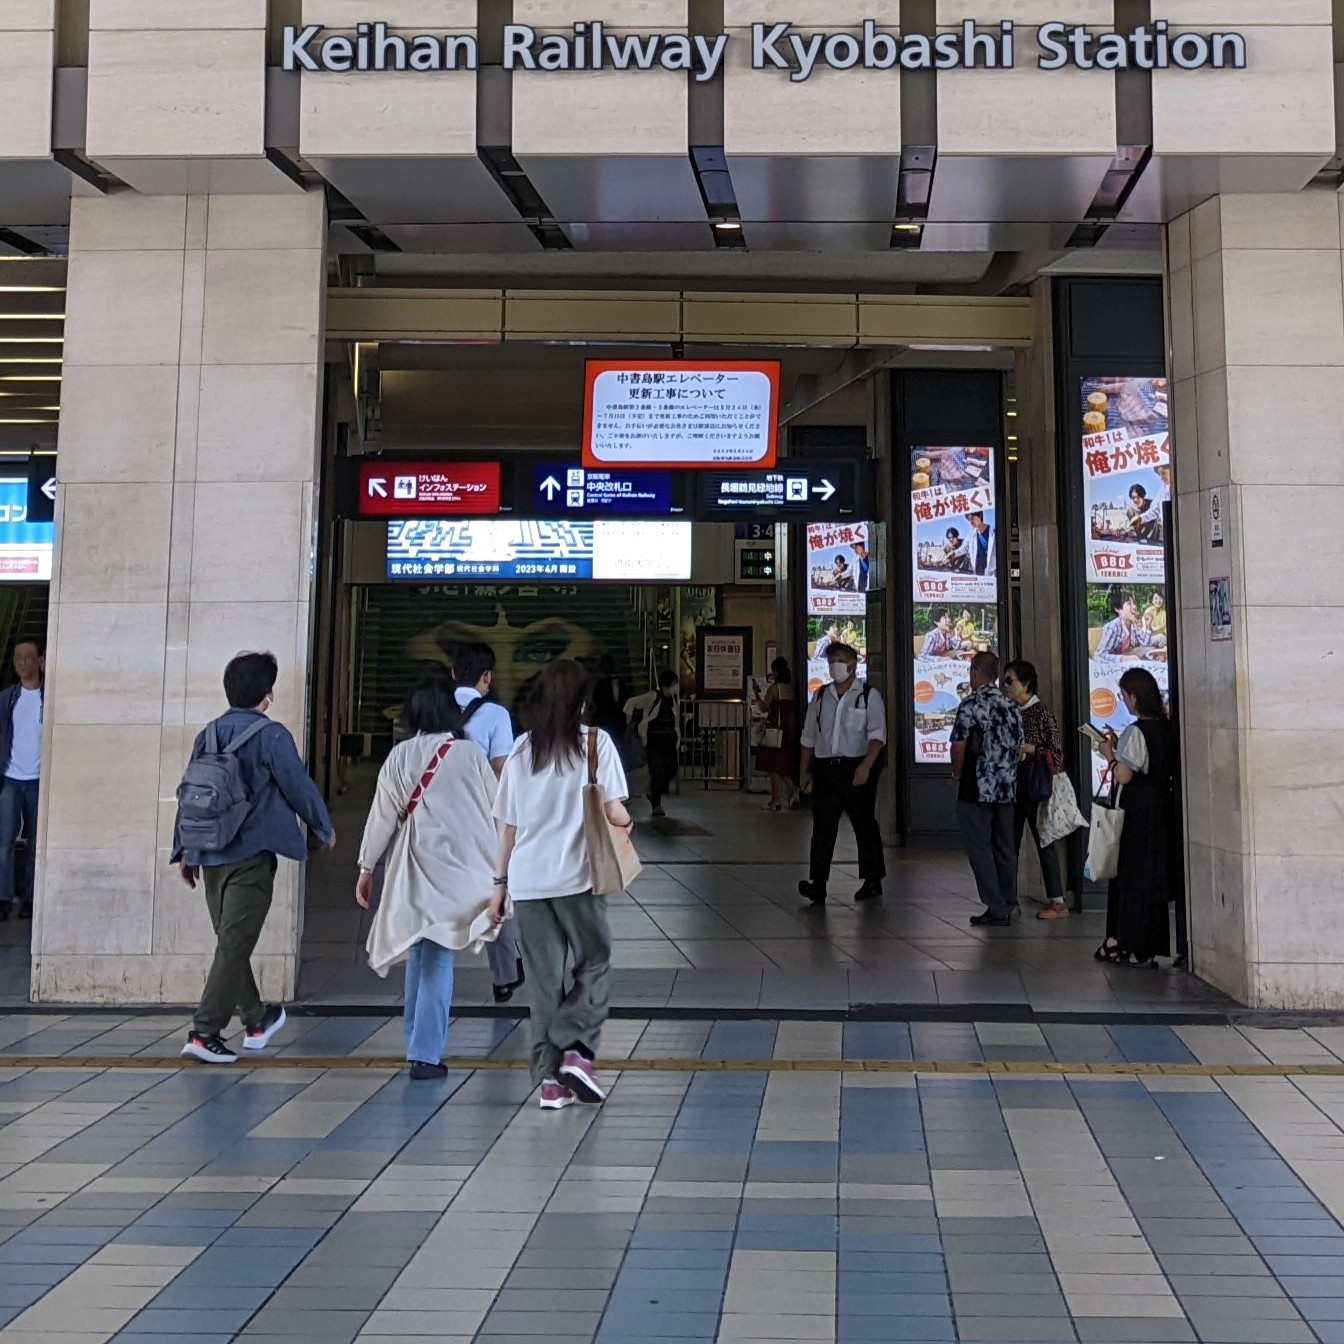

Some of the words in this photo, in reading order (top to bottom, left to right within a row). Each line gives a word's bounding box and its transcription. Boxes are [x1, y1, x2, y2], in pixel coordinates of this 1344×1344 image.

[281, 25, 478, 72] Keihan
[502, 24, 728, 82] Railway
[750, 20, 1015, 82] Kyobashi
[1036, 20, 1247, 70] Station
[617, 372, 739, 385] 中書島駅エレベーター
[628, 388, 726, 400] 更新工事について
[1083, 431, 1123, 449] 和牛!は
[418, 475, 448, 483] けいはん
[418, 484, 487, 492] インフォステーション
[586, 482, 632, 492] 中央改札口
[914, 488, 992, 522] 俺が焼く!
[1100, 556, 1126, 567] BBQ
[391, 563, 455, 575] 現代社会学部
[924, 582, 943, 591] BBQ
